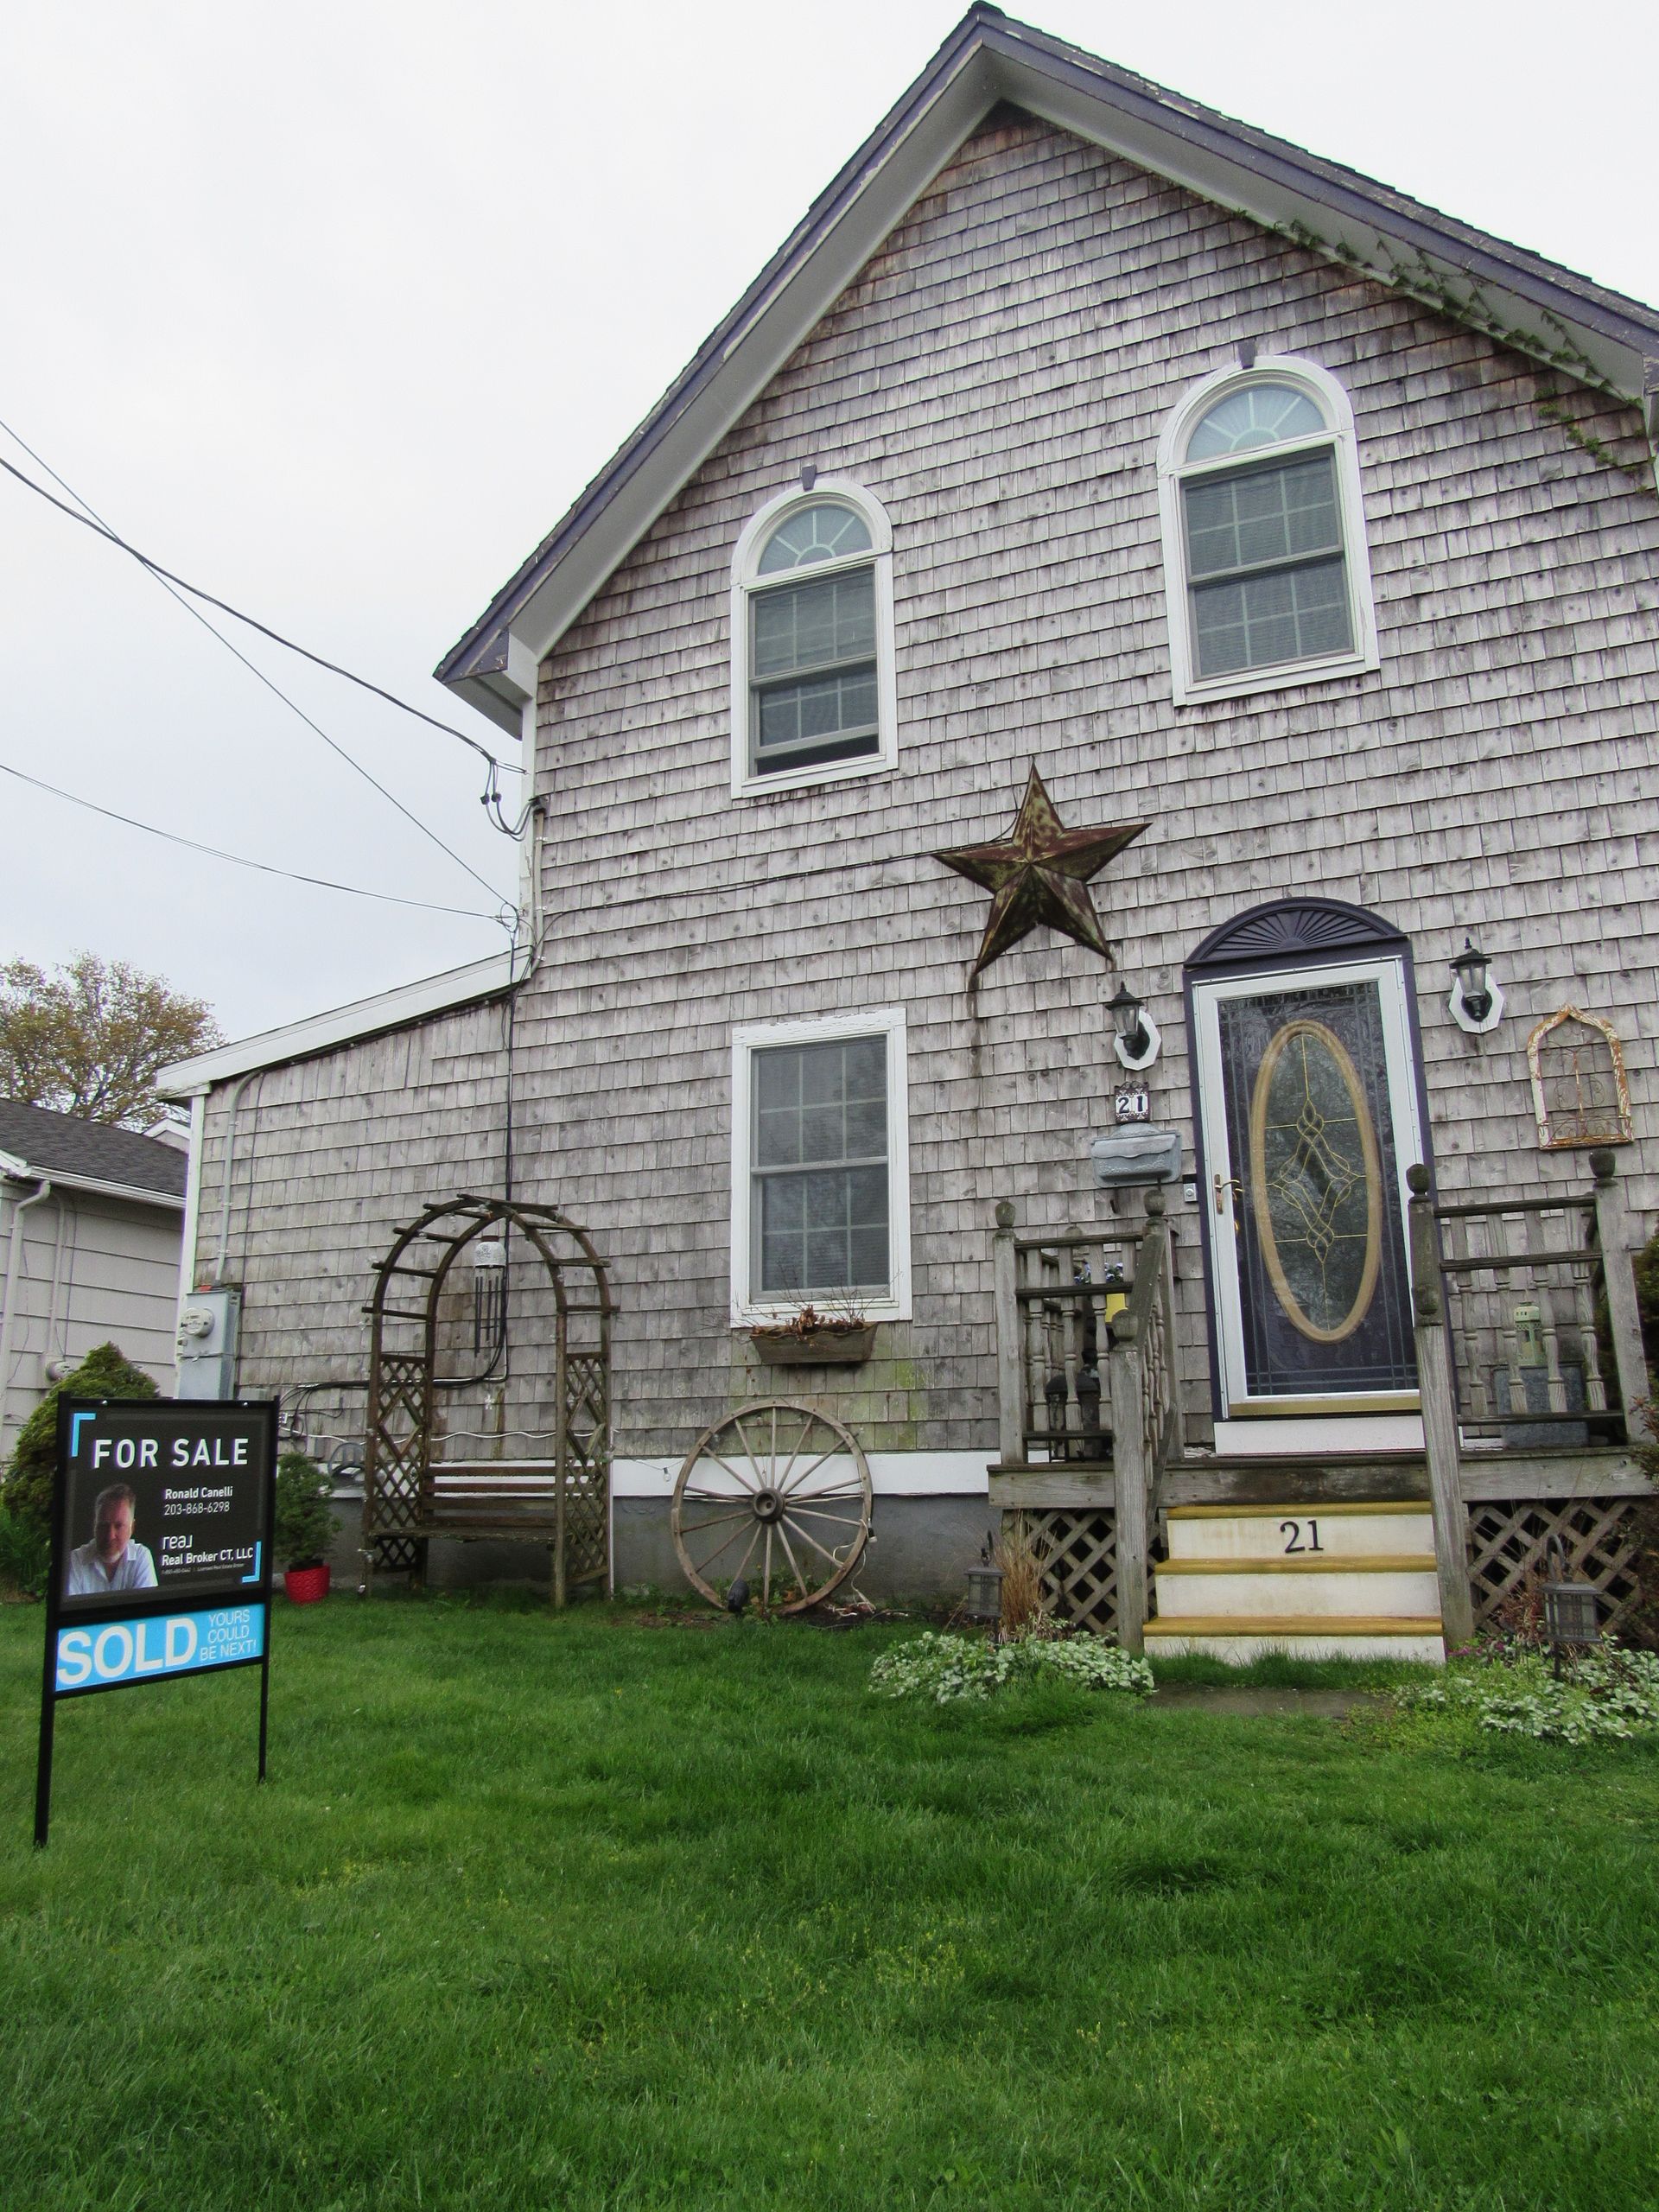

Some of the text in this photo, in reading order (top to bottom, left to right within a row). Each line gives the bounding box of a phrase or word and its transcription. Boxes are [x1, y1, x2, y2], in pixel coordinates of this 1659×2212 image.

[1118, 1095, 1143, 1114] 21
[93, 1438, 249, 1468] FOR SALE
[165, 1486, 233, 1499] Ronald Canelli
[164, 1501, 230, 1516] 203-868-6298
[1280, 1520, 1324, 1553] 21
[162, 1547, 254, 1566] Real Broker CT, LLC
[208, 1609, 250, 1627] YOURS
[208, 1624, 250, 1643] COULD
[56, 1618, 198, 1684] SOLD
[200, 1639, 257, 1661] BE NEXT!
